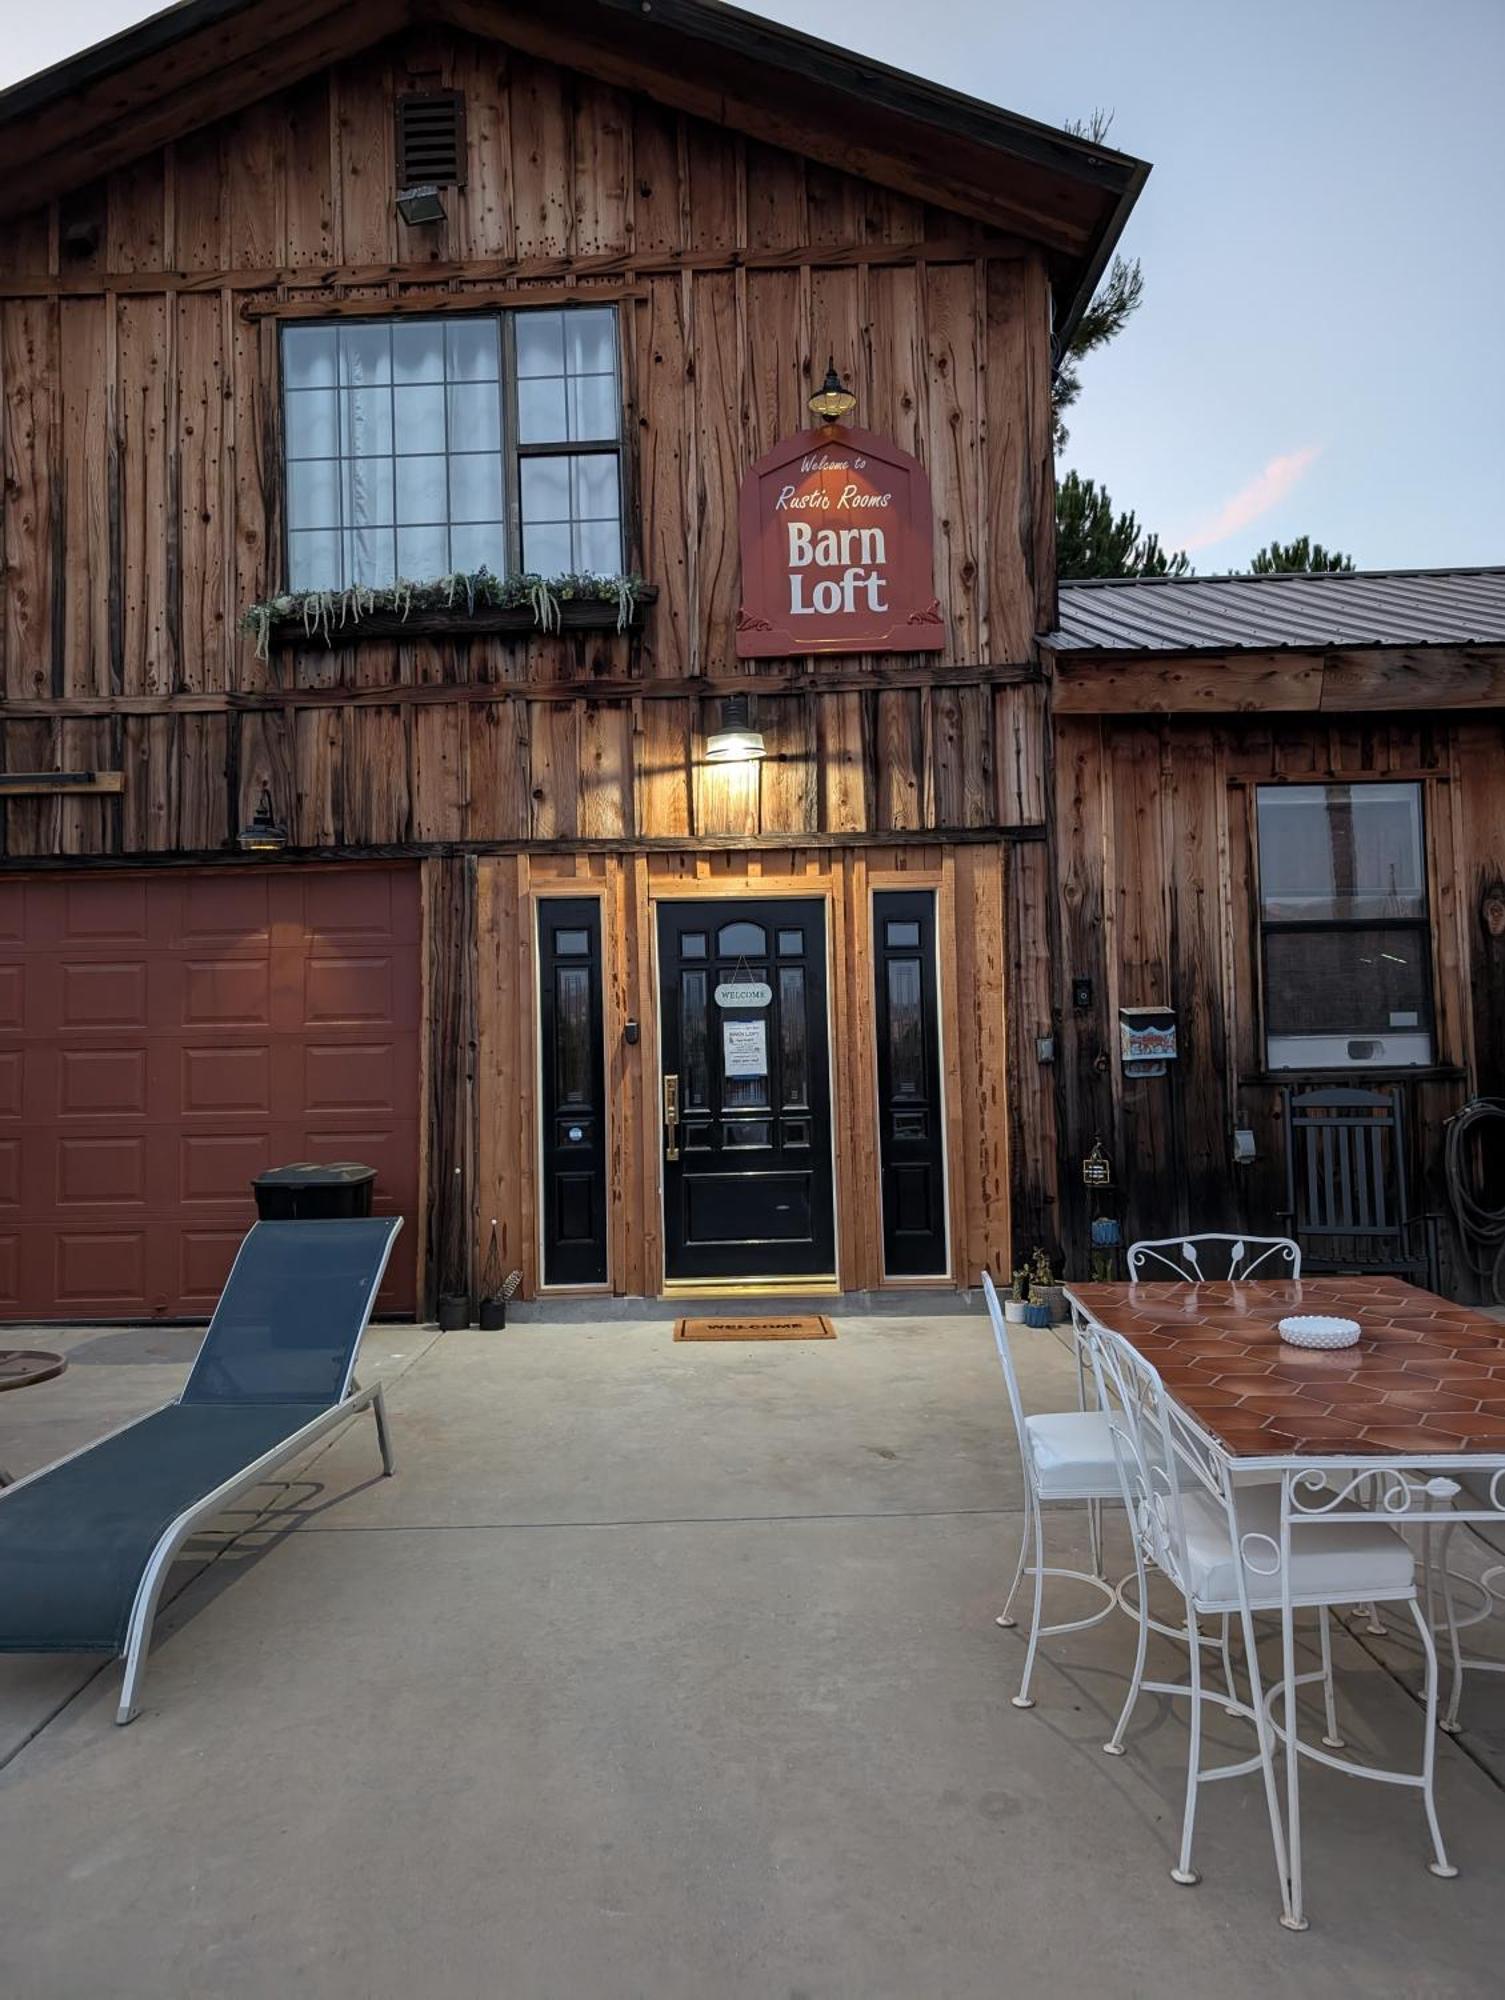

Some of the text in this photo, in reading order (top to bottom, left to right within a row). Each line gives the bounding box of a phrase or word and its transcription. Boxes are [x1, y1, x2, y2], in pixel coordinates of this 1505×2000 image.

[801, 455, 867, 472] Welcome to
[775, 484, 892, 510] Rustic Rooms
[787, 522, 886, 567] Barn
[789, 567, 888, 615] Loft
[721, 991, 765, 999] WELCOME
